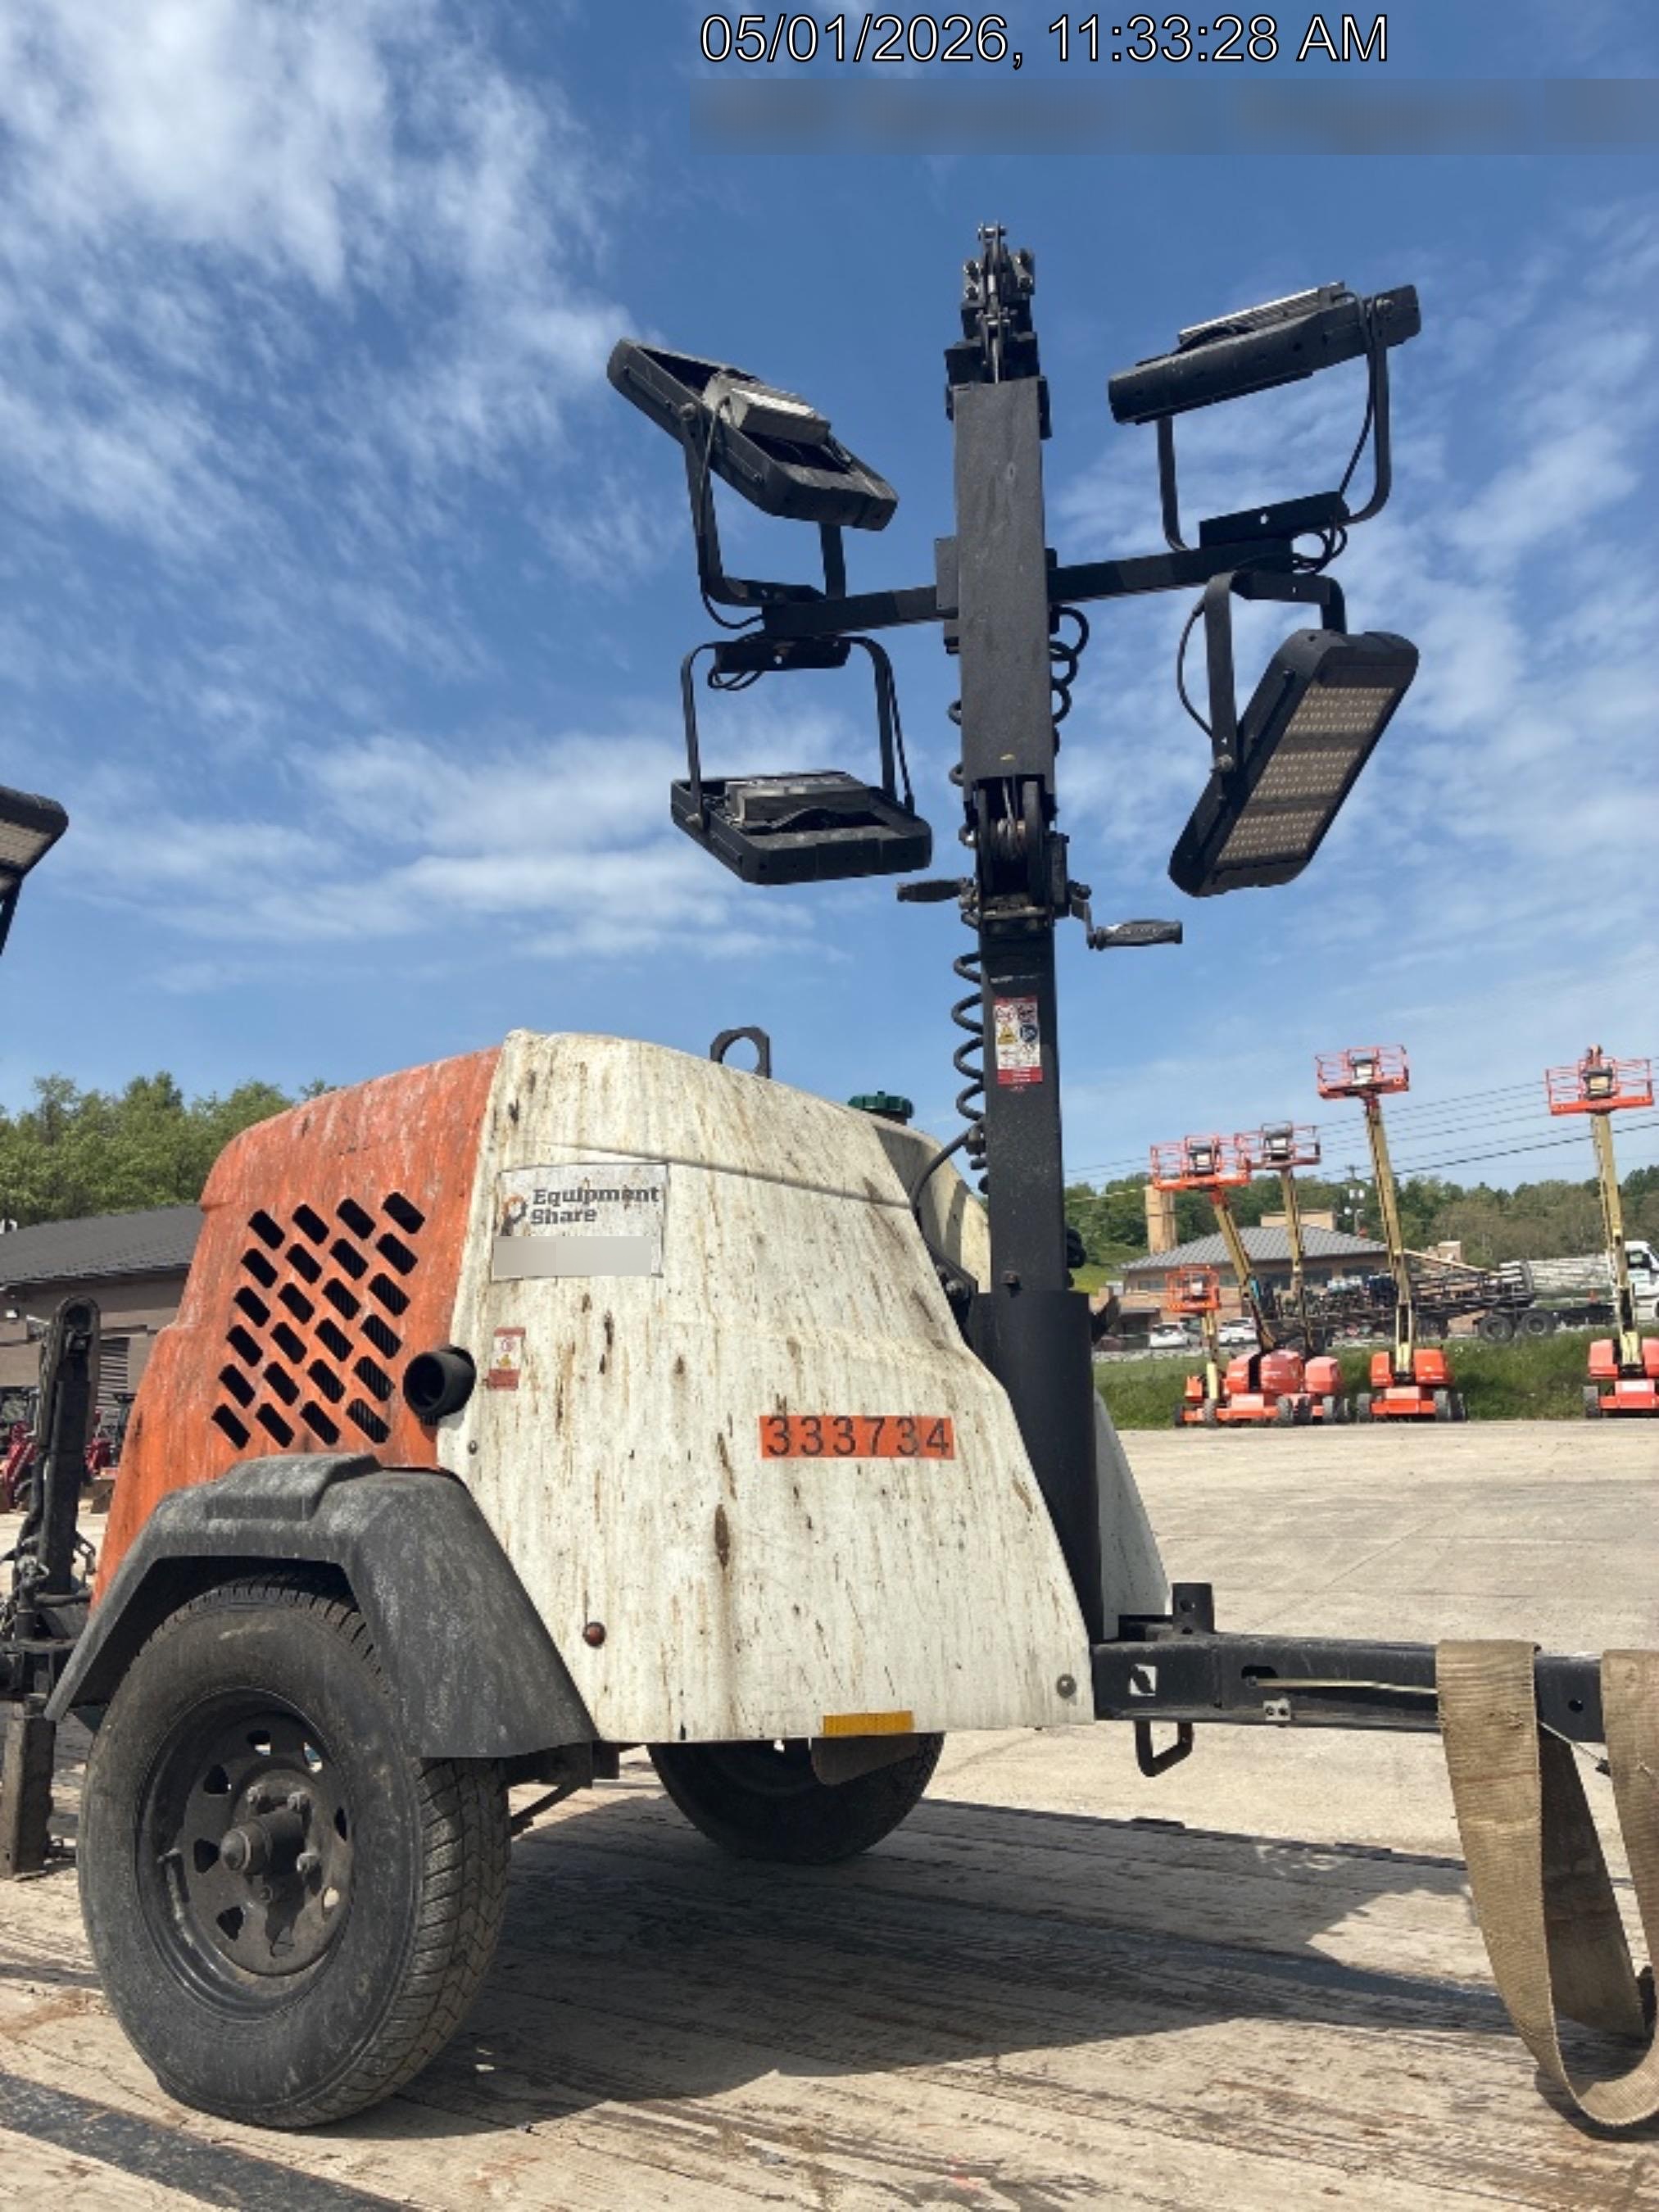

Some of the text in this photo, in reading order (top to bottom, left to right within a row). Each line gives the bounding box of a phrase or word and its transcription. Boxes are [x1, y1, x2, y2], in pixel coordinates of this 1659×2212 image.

[533, 1187, 660, 1206] Equipment
[530, 1208, 598, 1226] Share
[765, 1415, 950, 1456] 333734
